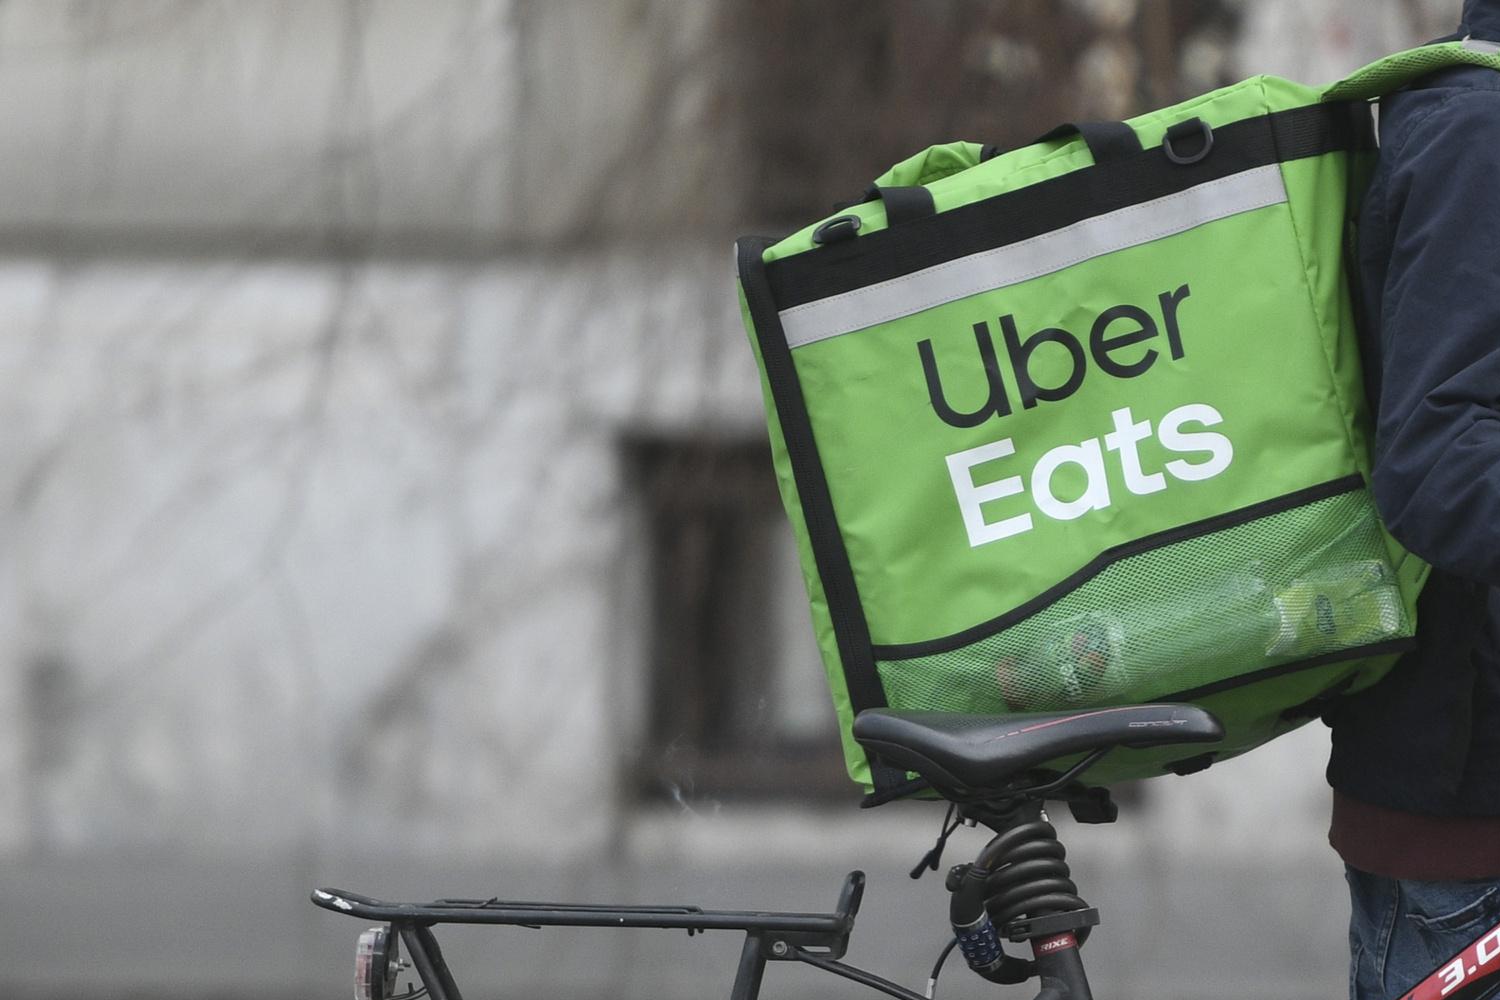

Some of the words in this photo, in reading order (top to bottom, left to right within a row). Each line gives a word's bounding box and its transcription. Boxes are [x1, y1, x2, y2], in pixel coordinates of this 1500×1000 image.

[917, 283, 1191, 429] Uber
[945, 403, 1234, 548] Eats
[1040, 937, 1069, 952] RIXE
